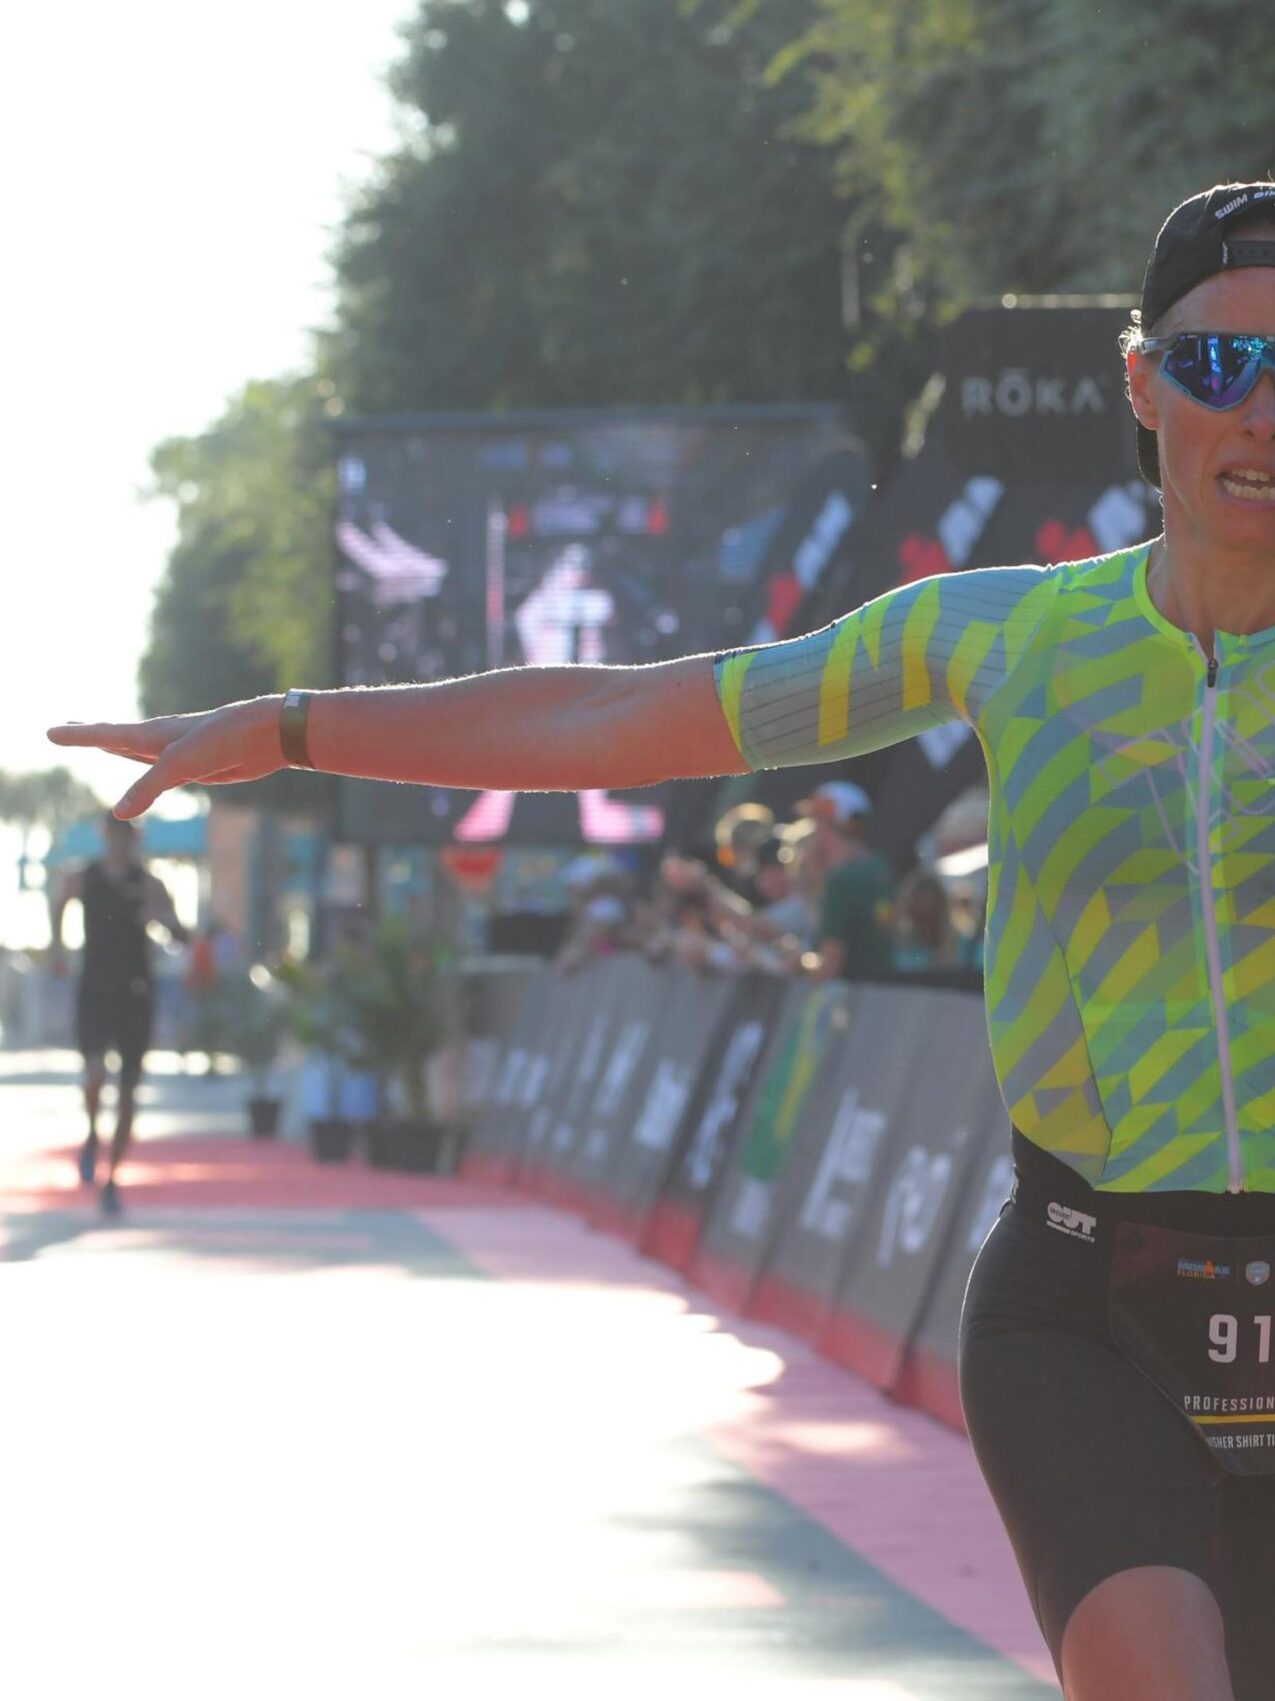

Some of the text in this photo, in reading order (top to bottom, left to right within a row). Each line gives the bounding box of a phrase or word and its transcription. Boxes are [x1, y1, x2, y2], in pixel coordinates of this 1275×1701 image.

[1214, 193, 1249, 220] SWIM
[1208, 1313, 1272, 1364] 91
[1235, 1434, 1266, 1449] SHIRT
